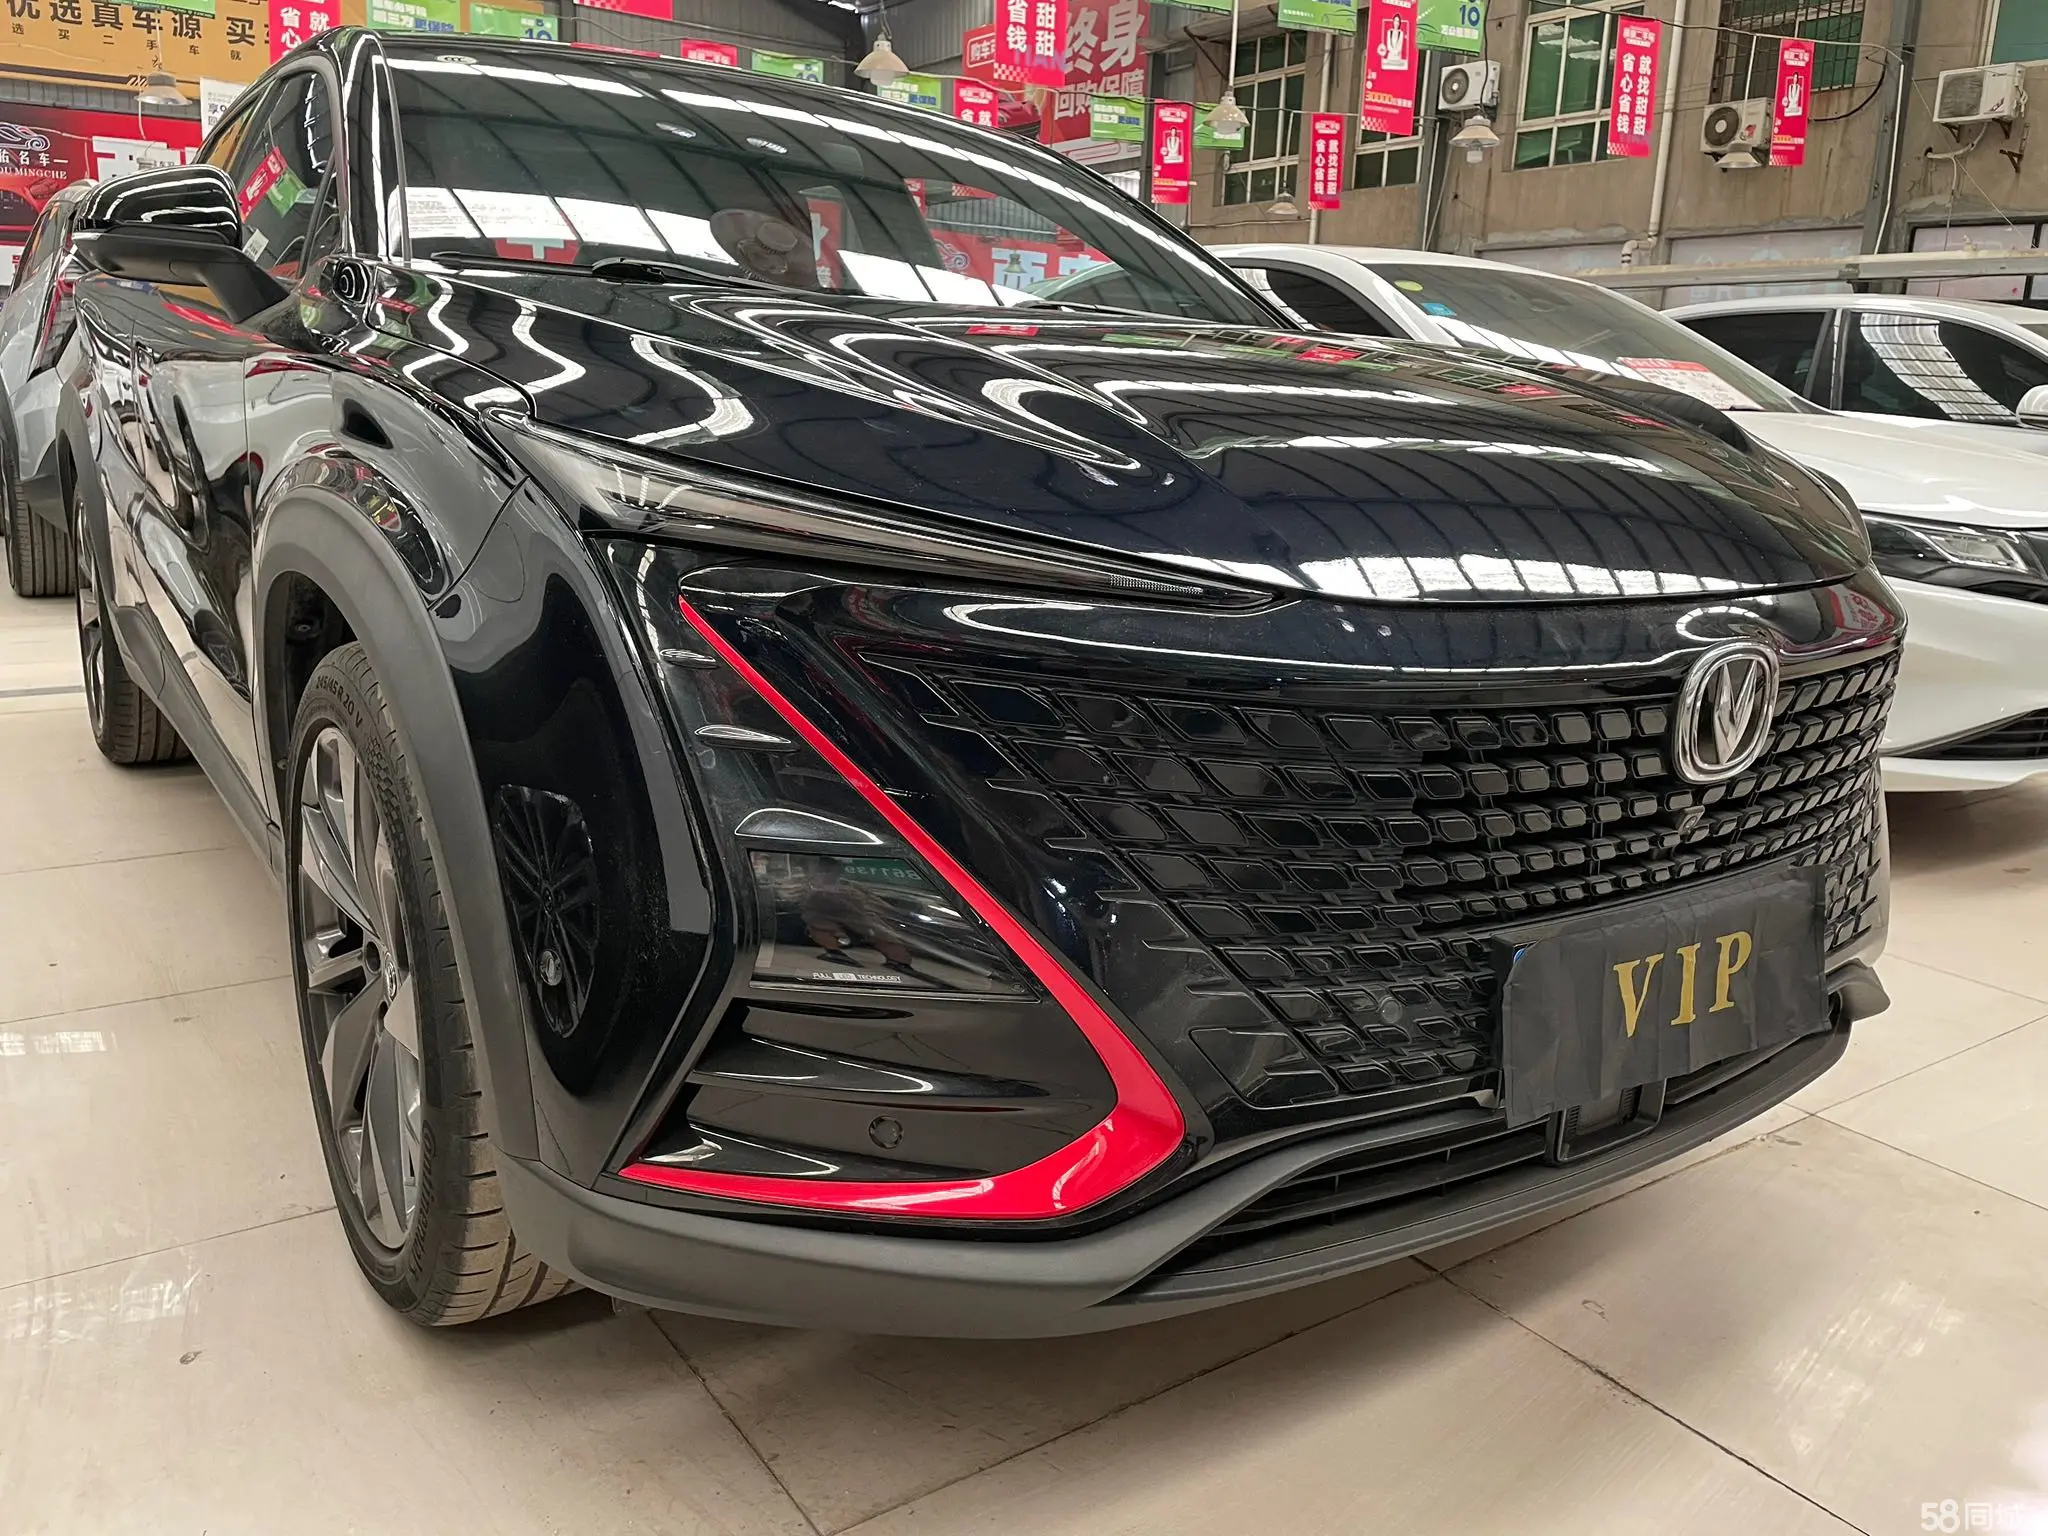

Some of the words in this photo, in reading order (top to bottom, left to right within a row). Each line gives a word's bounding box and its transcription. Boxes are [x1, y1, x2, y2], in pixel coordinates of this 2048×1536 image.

[1459, 8, 1480, 27] 10
[1616, 52, 1636, 135] 省心省钱
[1633, 54, 1652, 136] 就找甜甜
[1612, 930, 1754, 1039] VIP
